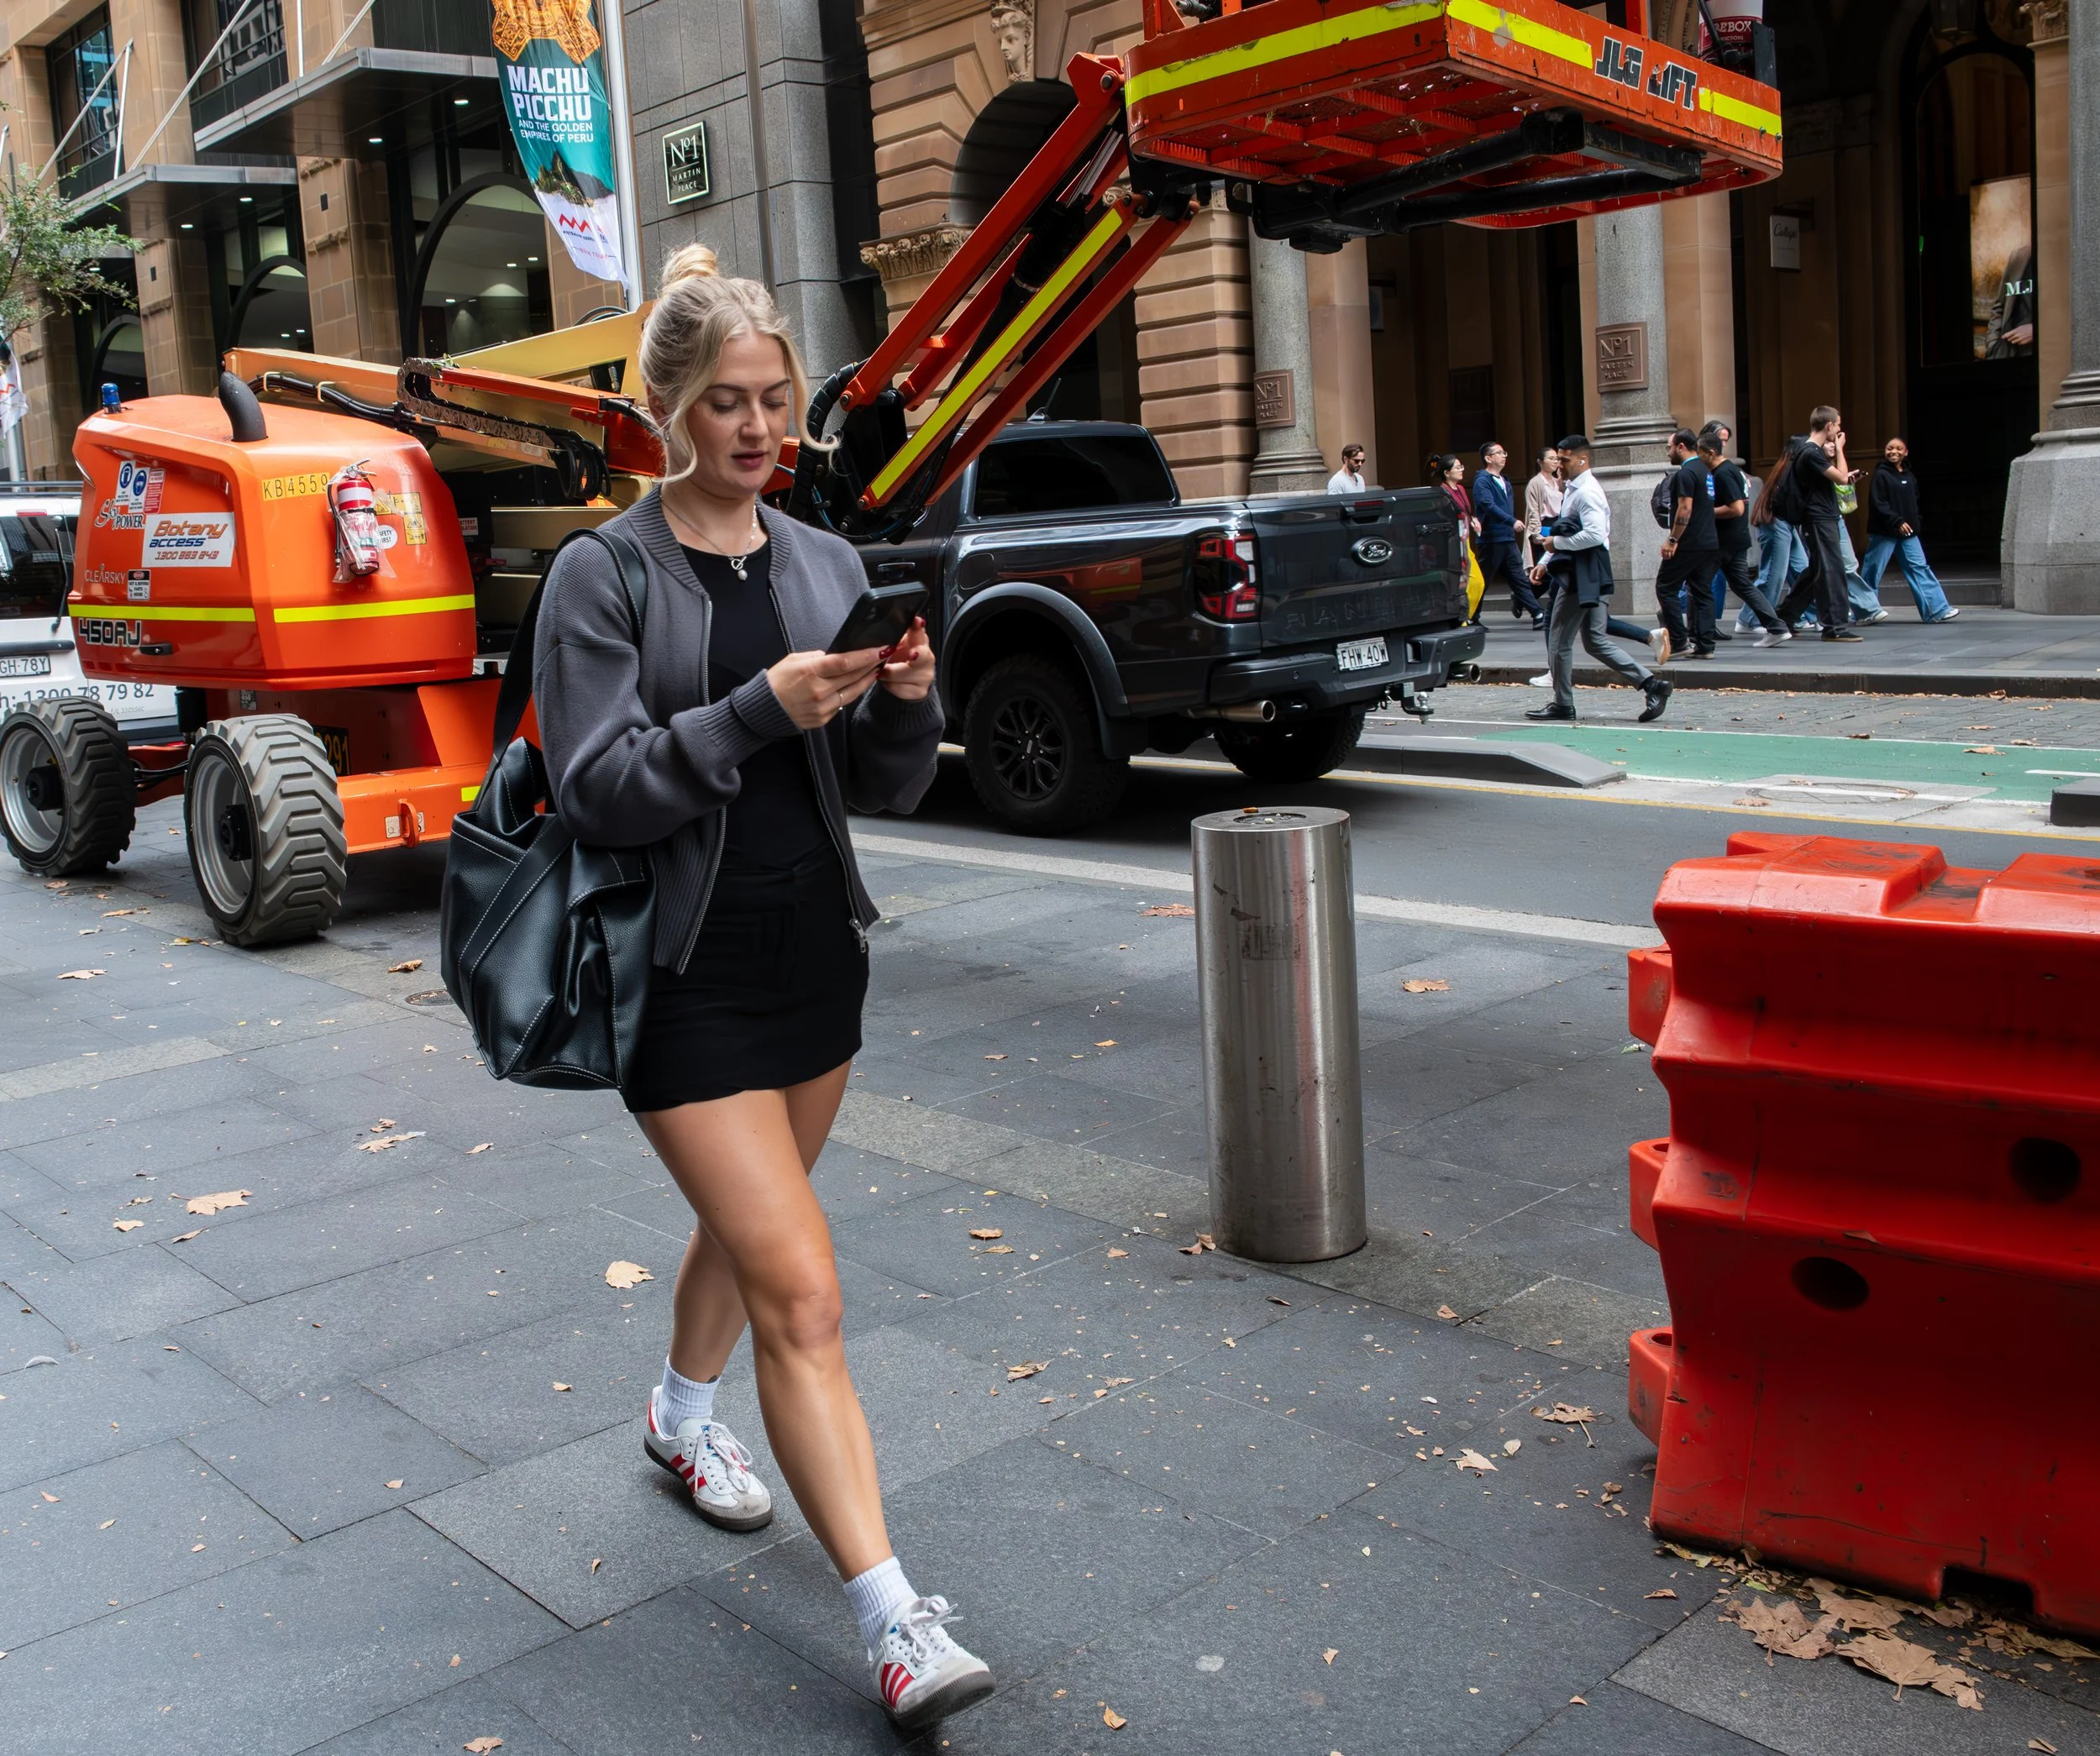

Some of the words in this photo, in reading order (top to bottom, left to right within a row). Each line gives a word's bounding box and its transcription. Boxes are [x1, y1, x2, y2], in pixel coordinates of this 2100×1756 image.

[507, 65, 590, 93] MACHU
[1594, 35, 1643, 90] JLG
[1646, 60, 1698, 111] LIFT
[511, 92, 592, 121] PICCHU
[518, 119, 534, 129] AND
[535, 122, 550, 132] THE
[552, 123, 593, 132] GOLDEN
[521, 129, 551, 141] EMPIRES
[552, 134, 566, 143] OF
[568, 134, 594, 143] PERU
[672, 168, 701, 182] MARTIN
[677, 181, 697, 192] PLACE
[263, 473, 328, 500] KB4559
[116, 515, 143, 528] POWER
[153, 520, 228, 539] Botany
[150, 537, 206, 548] access
[155, 551, 178, 560] 1300
[84, 569, 125, 584] CLEARSKY
[78, 618, 142, 647] 450AJ
[77, 685, 100, 702] 78
[106, 684, 128, 700] 79
[134, 684, 155, 699] 82
